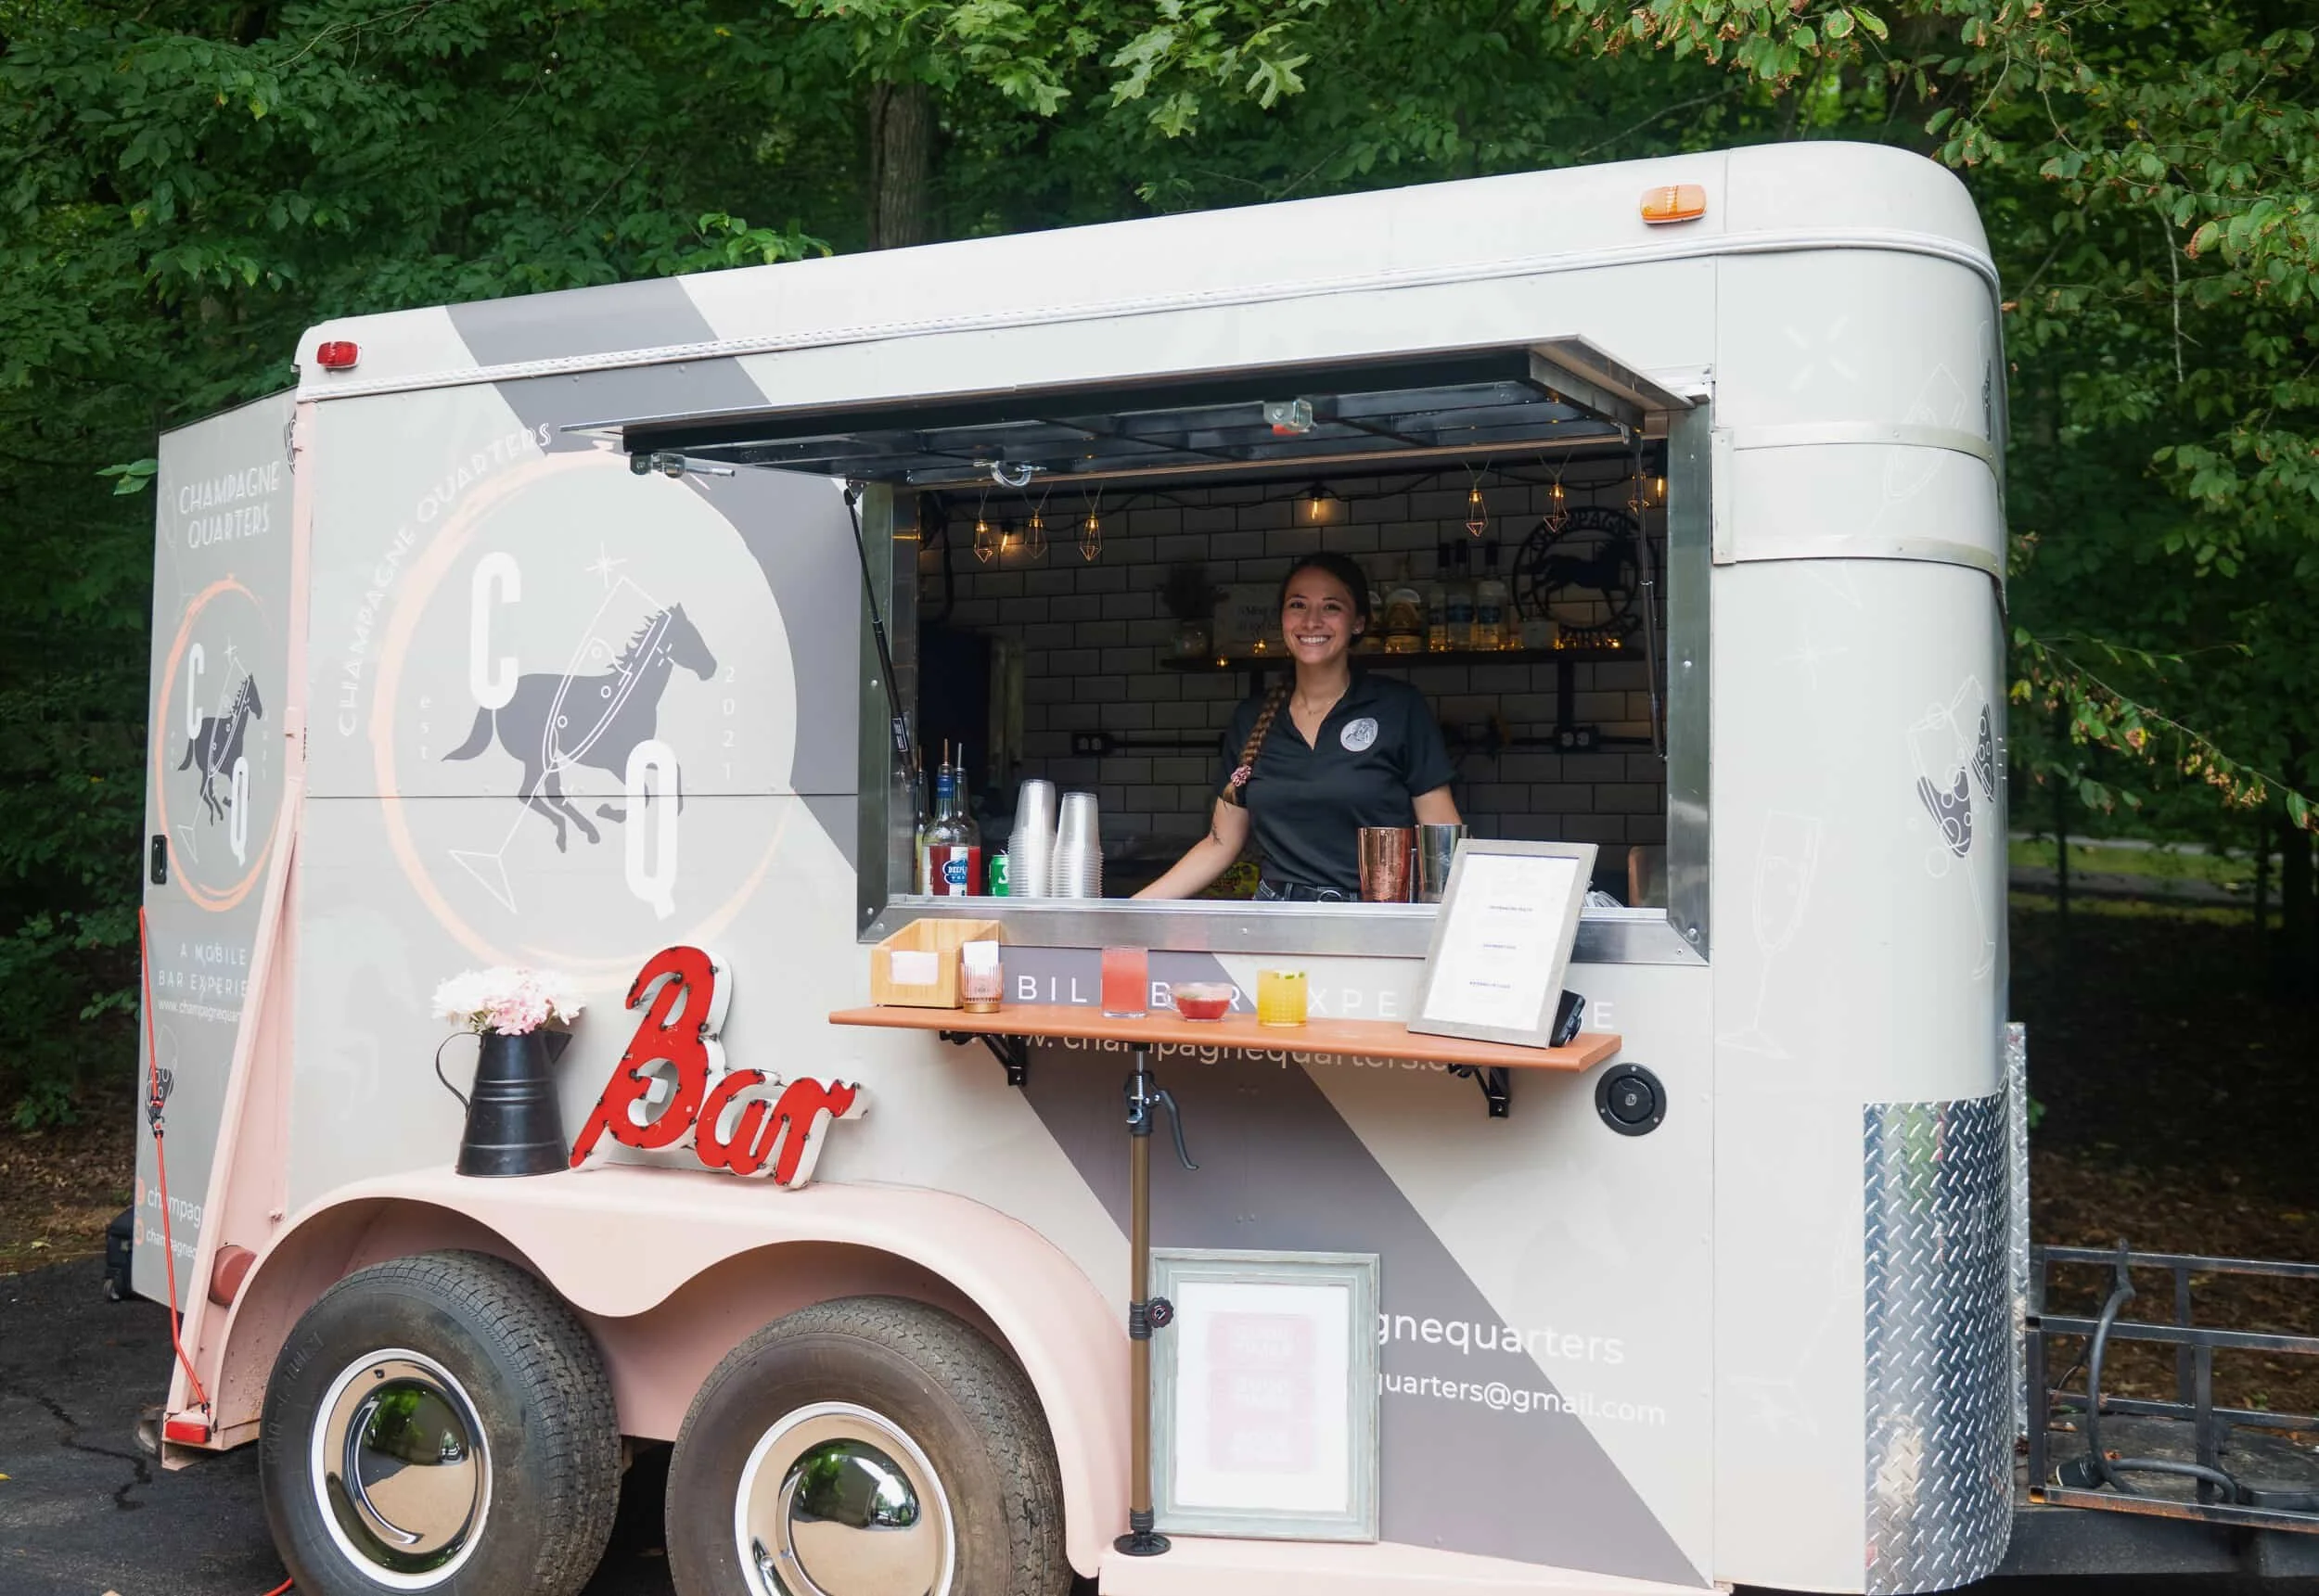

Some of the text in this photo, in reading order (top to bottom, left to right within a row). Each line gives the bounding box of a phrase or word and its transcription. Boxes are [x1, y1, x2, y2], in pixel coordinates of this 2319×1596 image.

[179, 461, 280, 515] CHAMPAGNE
[187, 503, 270, 549] QUARTERS
[338, 422, 551, 738] CHAMPAGNE QUARTERS
[470, 552, 521, 709] C
[187, 643, 205, 740] C
[229, 756, 250, 867] Q
[625, 738, 677, 920] Q
[159, 970, 184, 988] BAR
[180, 941, 246, 965] A MOBILE
[1018, 975, 1103, 1003] BIL
[1151, 981, 1241, 1011] BR
[569, 945, 870, 1189] Bar
